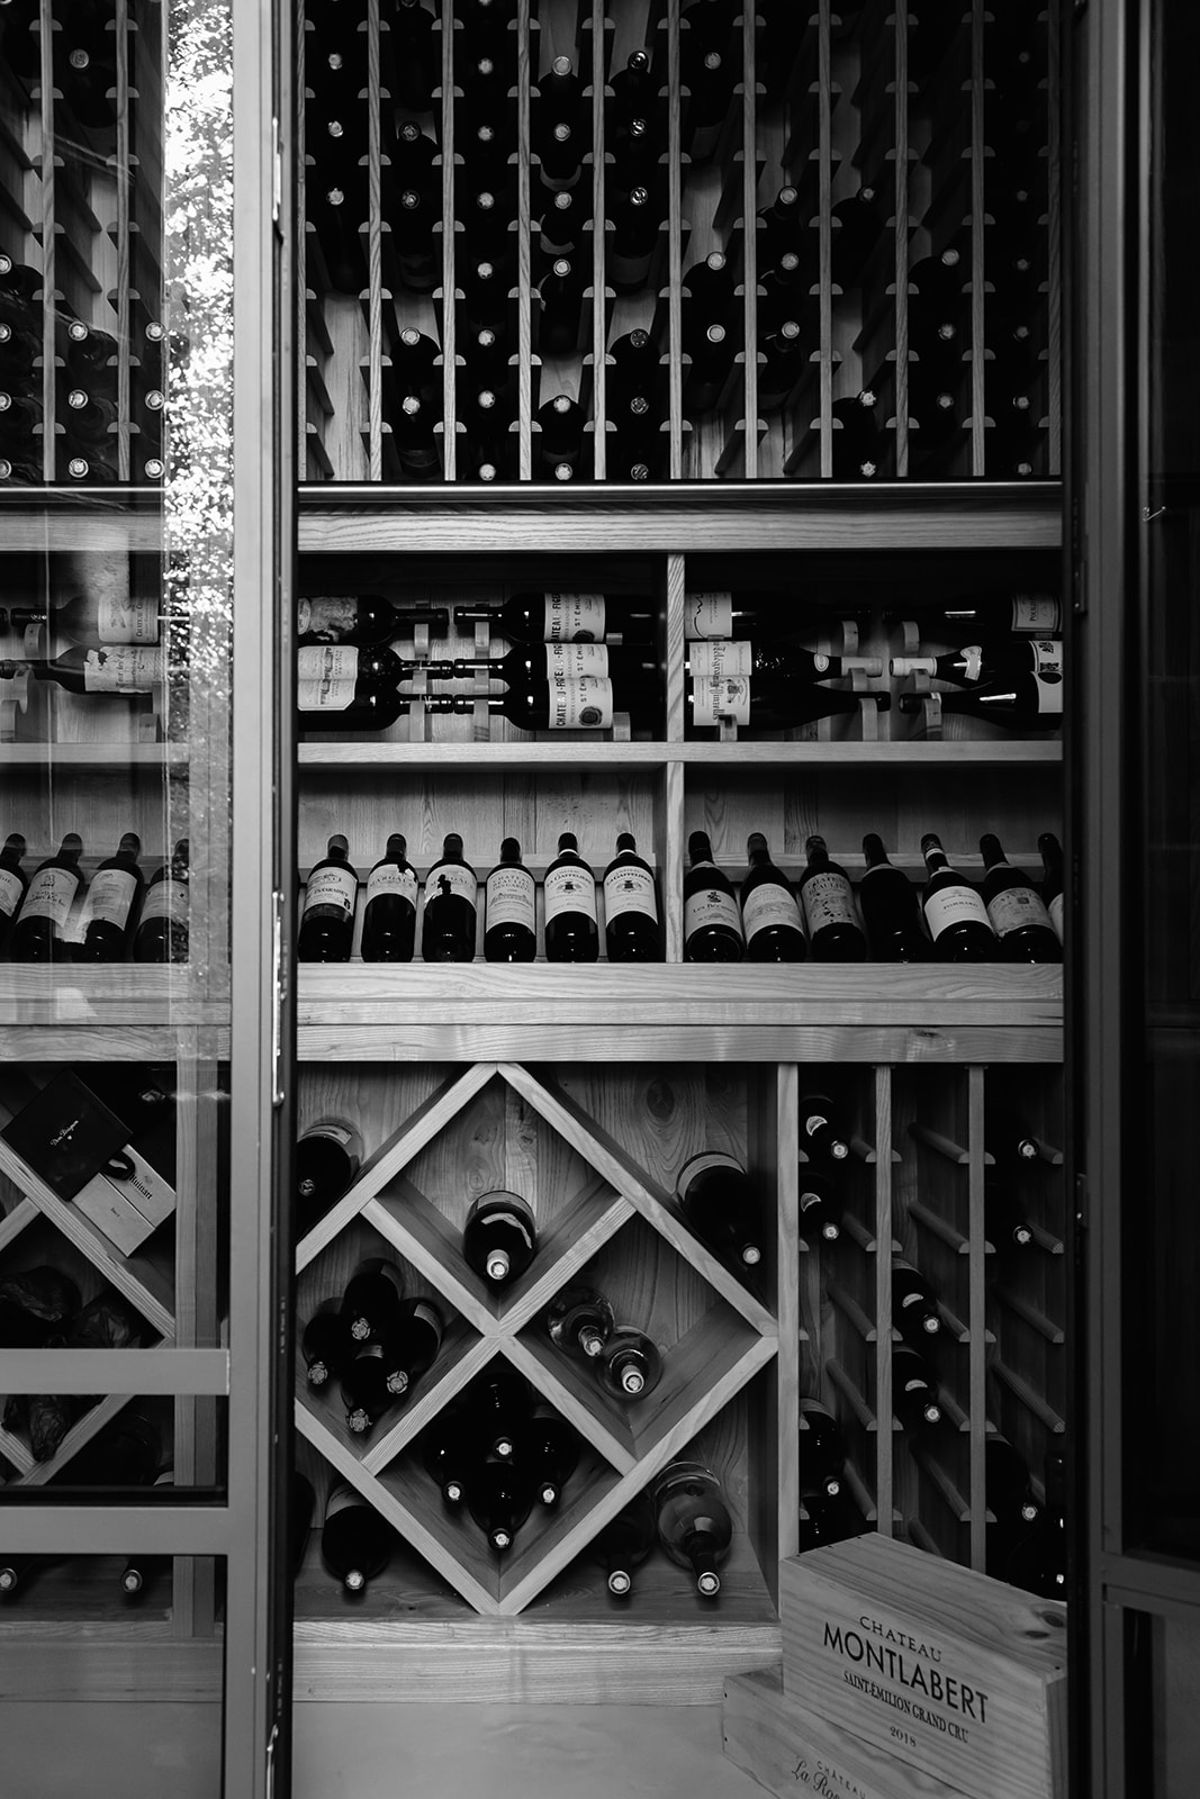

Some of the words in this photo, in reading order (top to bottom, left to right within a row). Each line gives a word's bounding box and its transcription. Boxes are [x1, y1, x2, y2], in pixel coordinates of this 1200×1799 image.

[859, 1616, 942, 1662] CHATEAU
[824, 1622, 988, 1723] MONTLABERT
[843, 1670, 911, 1714] SAINT-ÉMILION
[912, 1703, 947, 1732] GRAND
[948, 1722, 969, 1744] CRU
[890, 1726, 917, 1748] 2018
[791, 1760, 810, 1783] La
